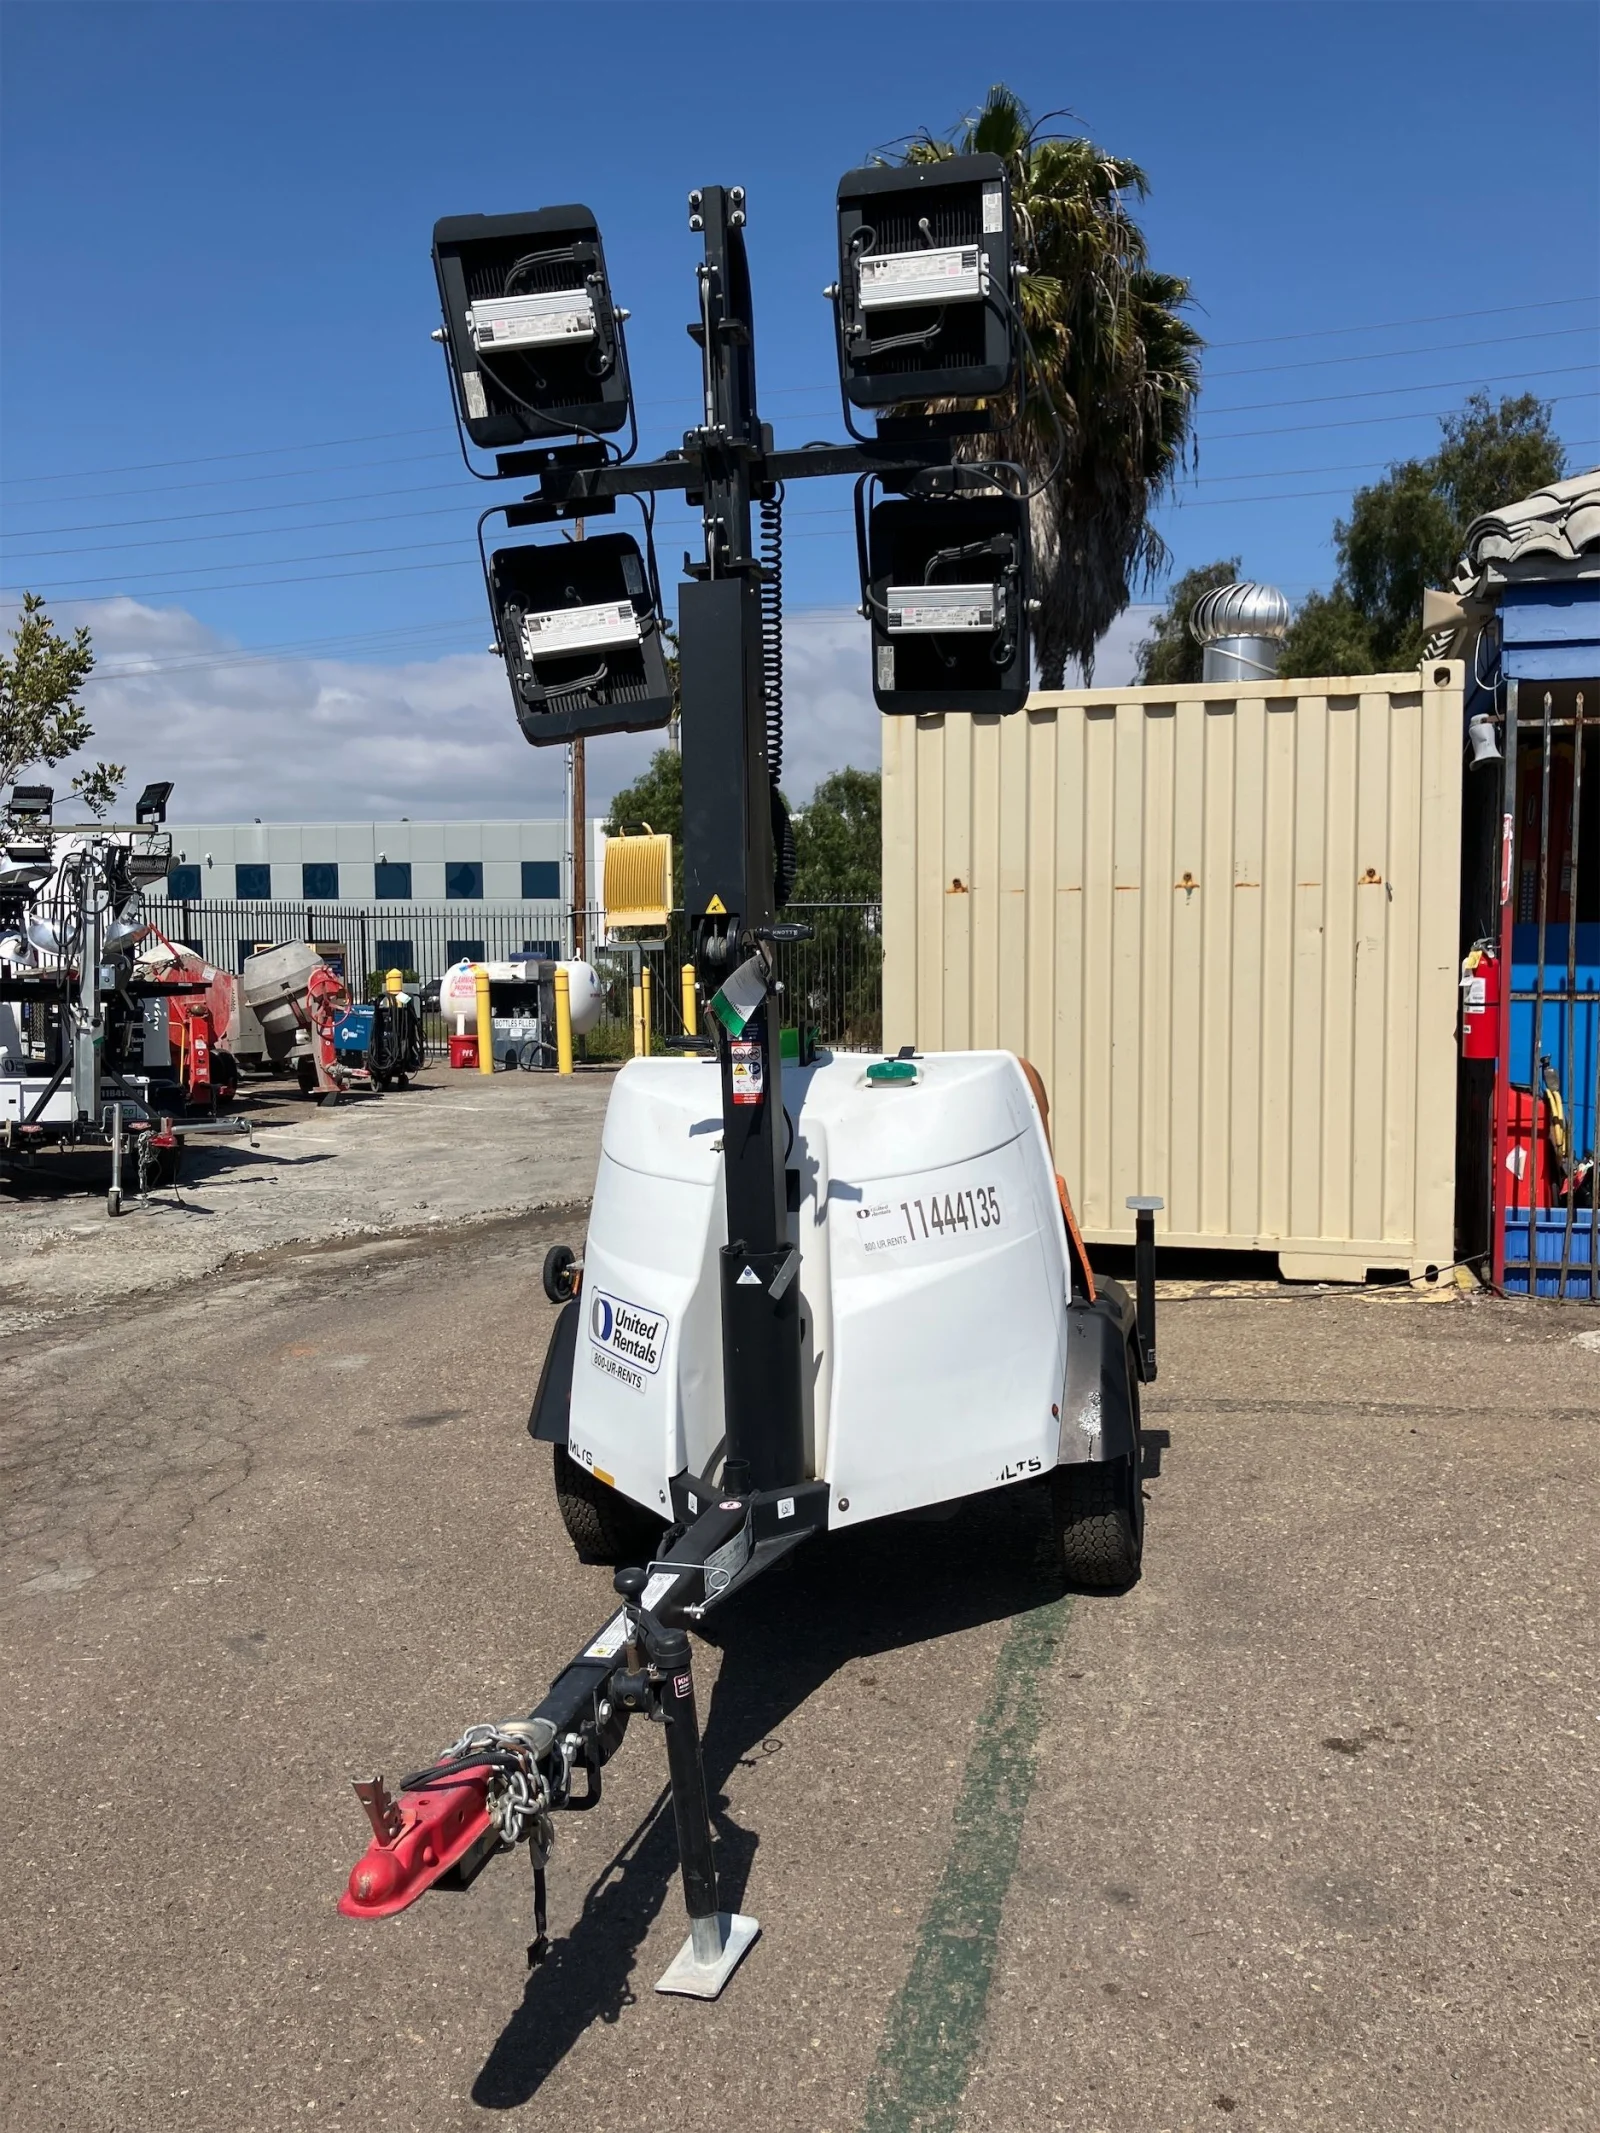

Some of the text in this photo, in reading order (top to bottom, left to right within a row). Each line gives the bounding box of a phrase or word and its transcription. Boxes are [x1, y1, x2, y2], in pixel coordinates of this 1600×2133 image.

[495, 1019, 536, 1028] BOTTLES FILLED
[900, 1186, 1001, 1241] 11444135
[615, 1307, 659, 1341] United
[612, 1328, 657, 1365] Rentals
[593, 1352, 643, 1389] 800-UR-RENTS
